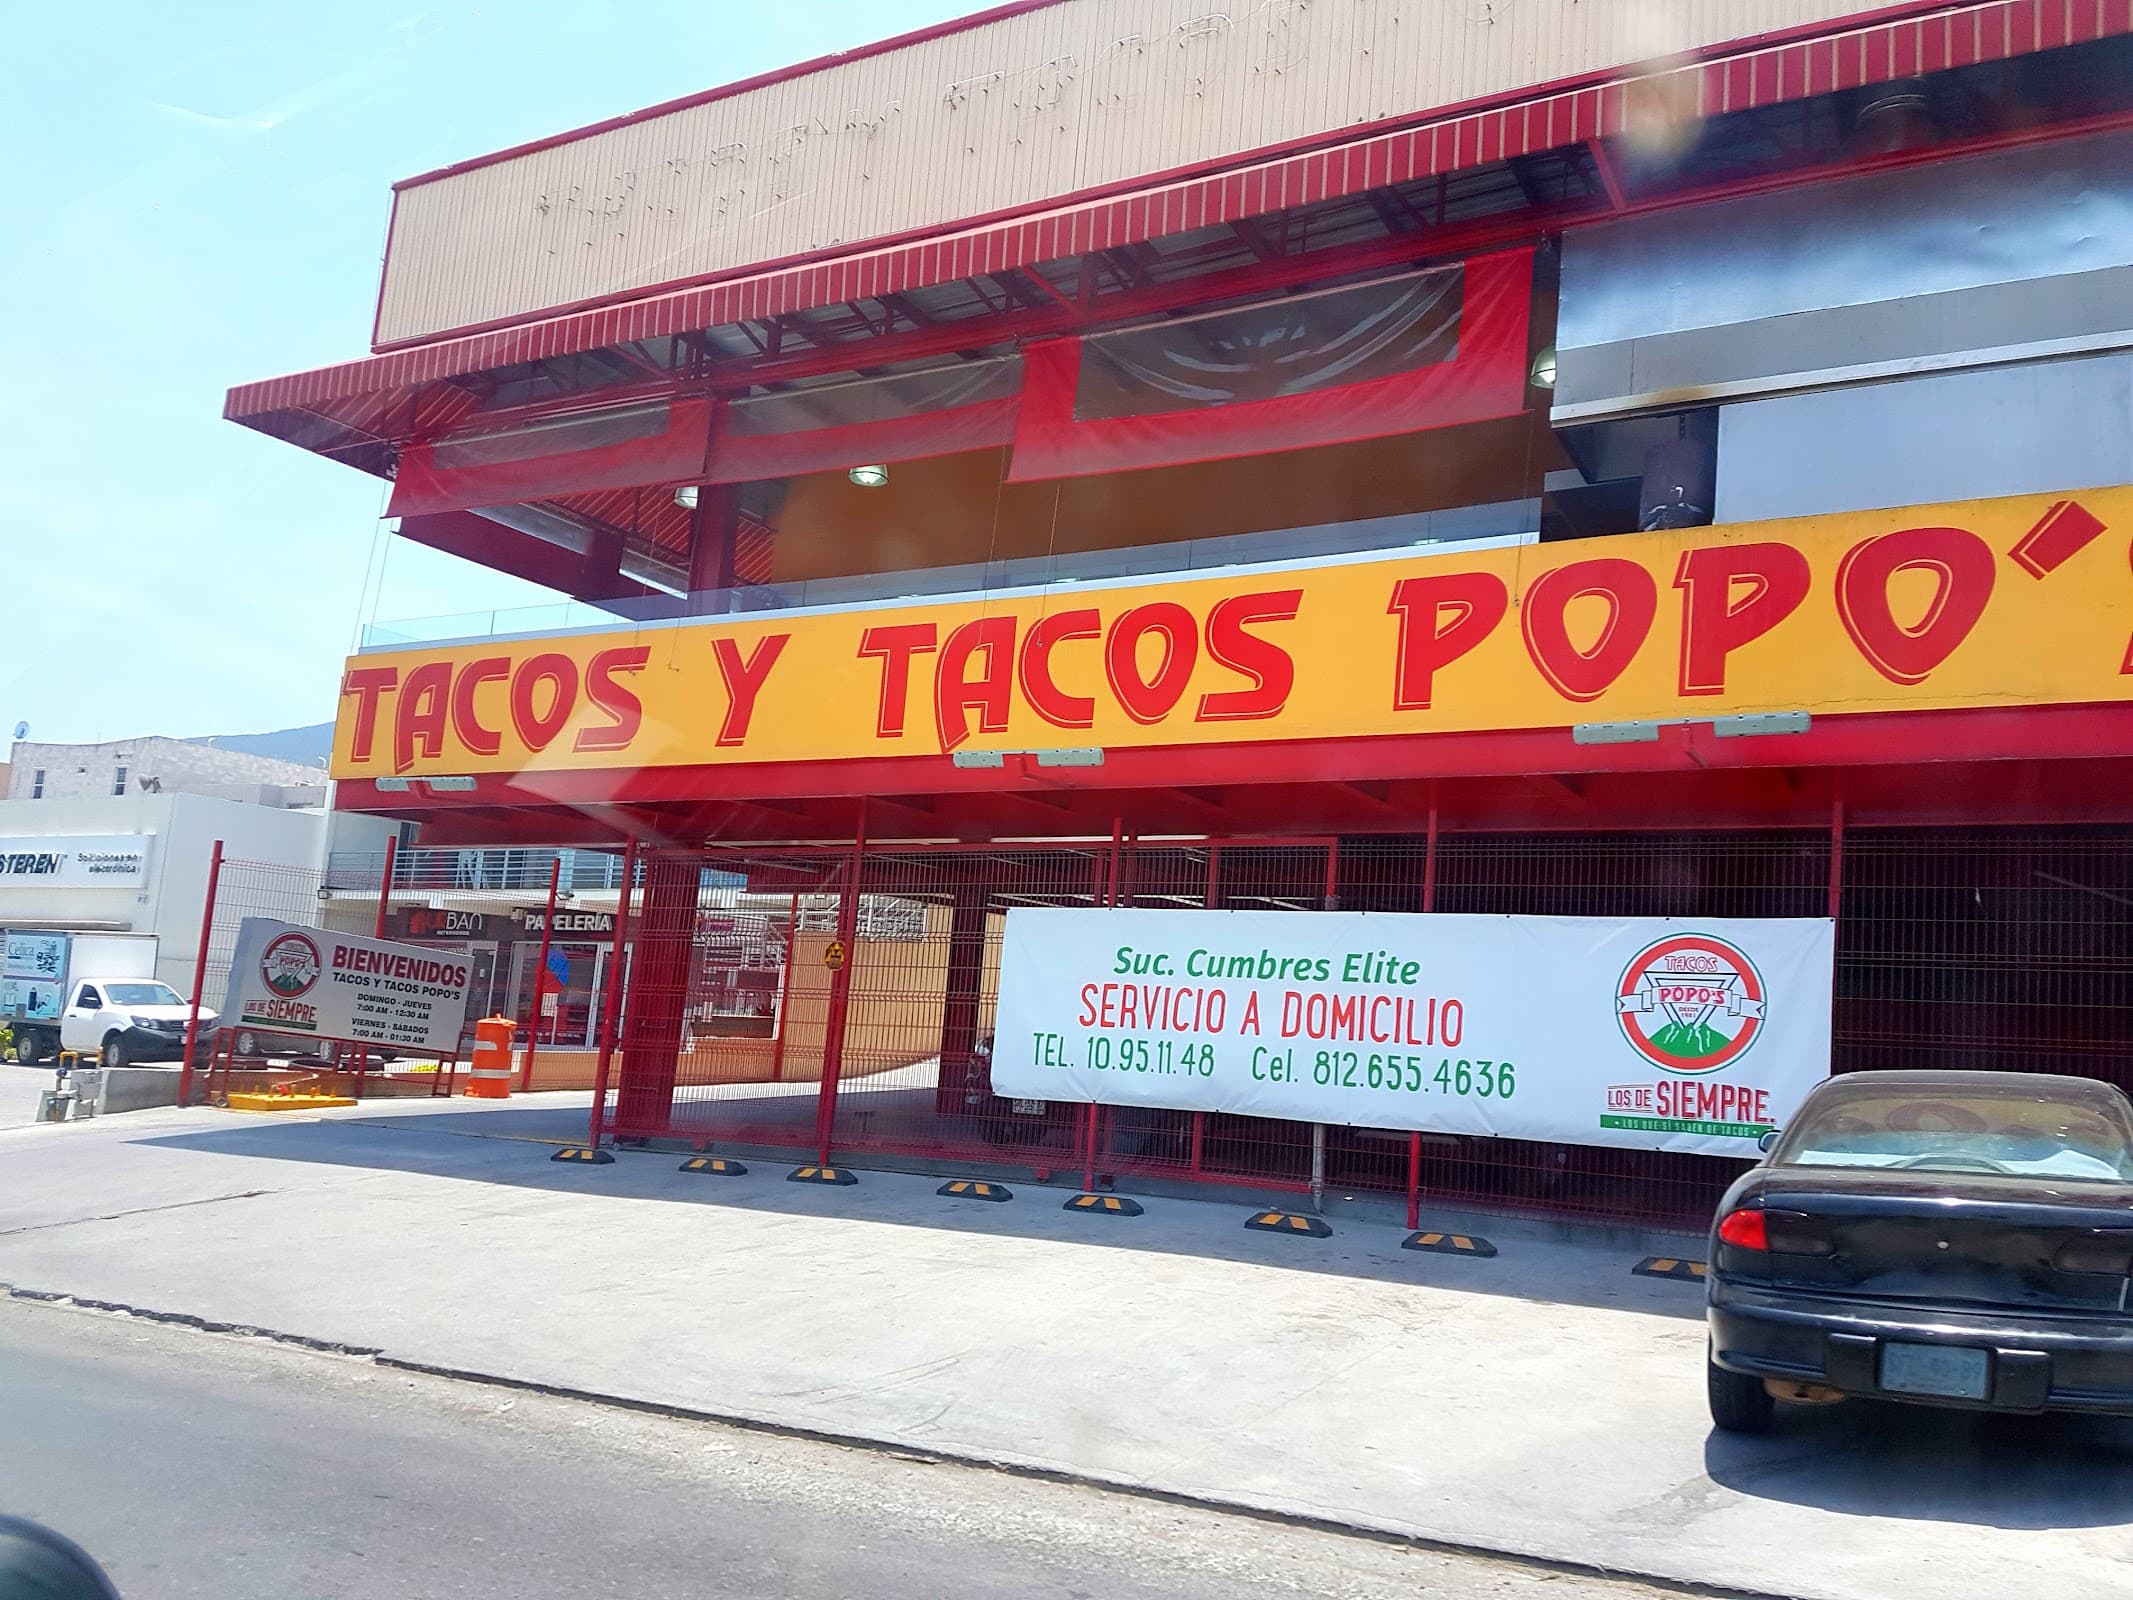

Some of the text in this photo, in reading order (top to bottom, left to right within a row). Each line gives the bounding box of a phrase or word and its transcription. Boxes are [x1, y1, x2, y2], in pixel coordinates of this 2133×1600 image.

[342, 500, 2133, 775] TACOS Y TACOS POPO'
[525, 913, 613, 931] PAELERÍA
[332, 944, 467, 988] BIENVENIDOS
[1113, 946, 1421, 985] Suc. Cumbres Elite
[1664, 955, 1719, 972] TACOS
[333, 971, 461, 1000] TACOS Y TACOS POPO'S
[357, 993, 396, 1005] DOMINGO
[402, 1000, 432, 1010] JUEVES
[1658, 986, 1726, 1005] POPO'S
[357, 1004, 374, 1012] 7:00
[395, 1009, 416, 1018] 12:30
[417, 1012, 430, 1020] AM
[1078, 983, 1465, 1047] SERVICIO A DOMICILIO
[351, 1018, 386, 1029] VIERNES
[352, 1029, 369, 1037] 7:00
[371, 1031, 383, 1039] AM
[389, 1034, 411, 1042] 01:30
[1033, 1032, 1516, 1099] TEL. 10.95.11.48 Cel. 812.655.4636
[1607, 1080, 1776, 1123] LOS DE SIEMPRE.
[1622, 1119, 1639, 1129] LOS
[1642, 1121, 1659, 1130] QUE
[1674, 1123, 1703, 1133] SABEN
[1707, 1124, 1717, 1134] DE
[1721, 1126, 1750, 1137] TACOS
